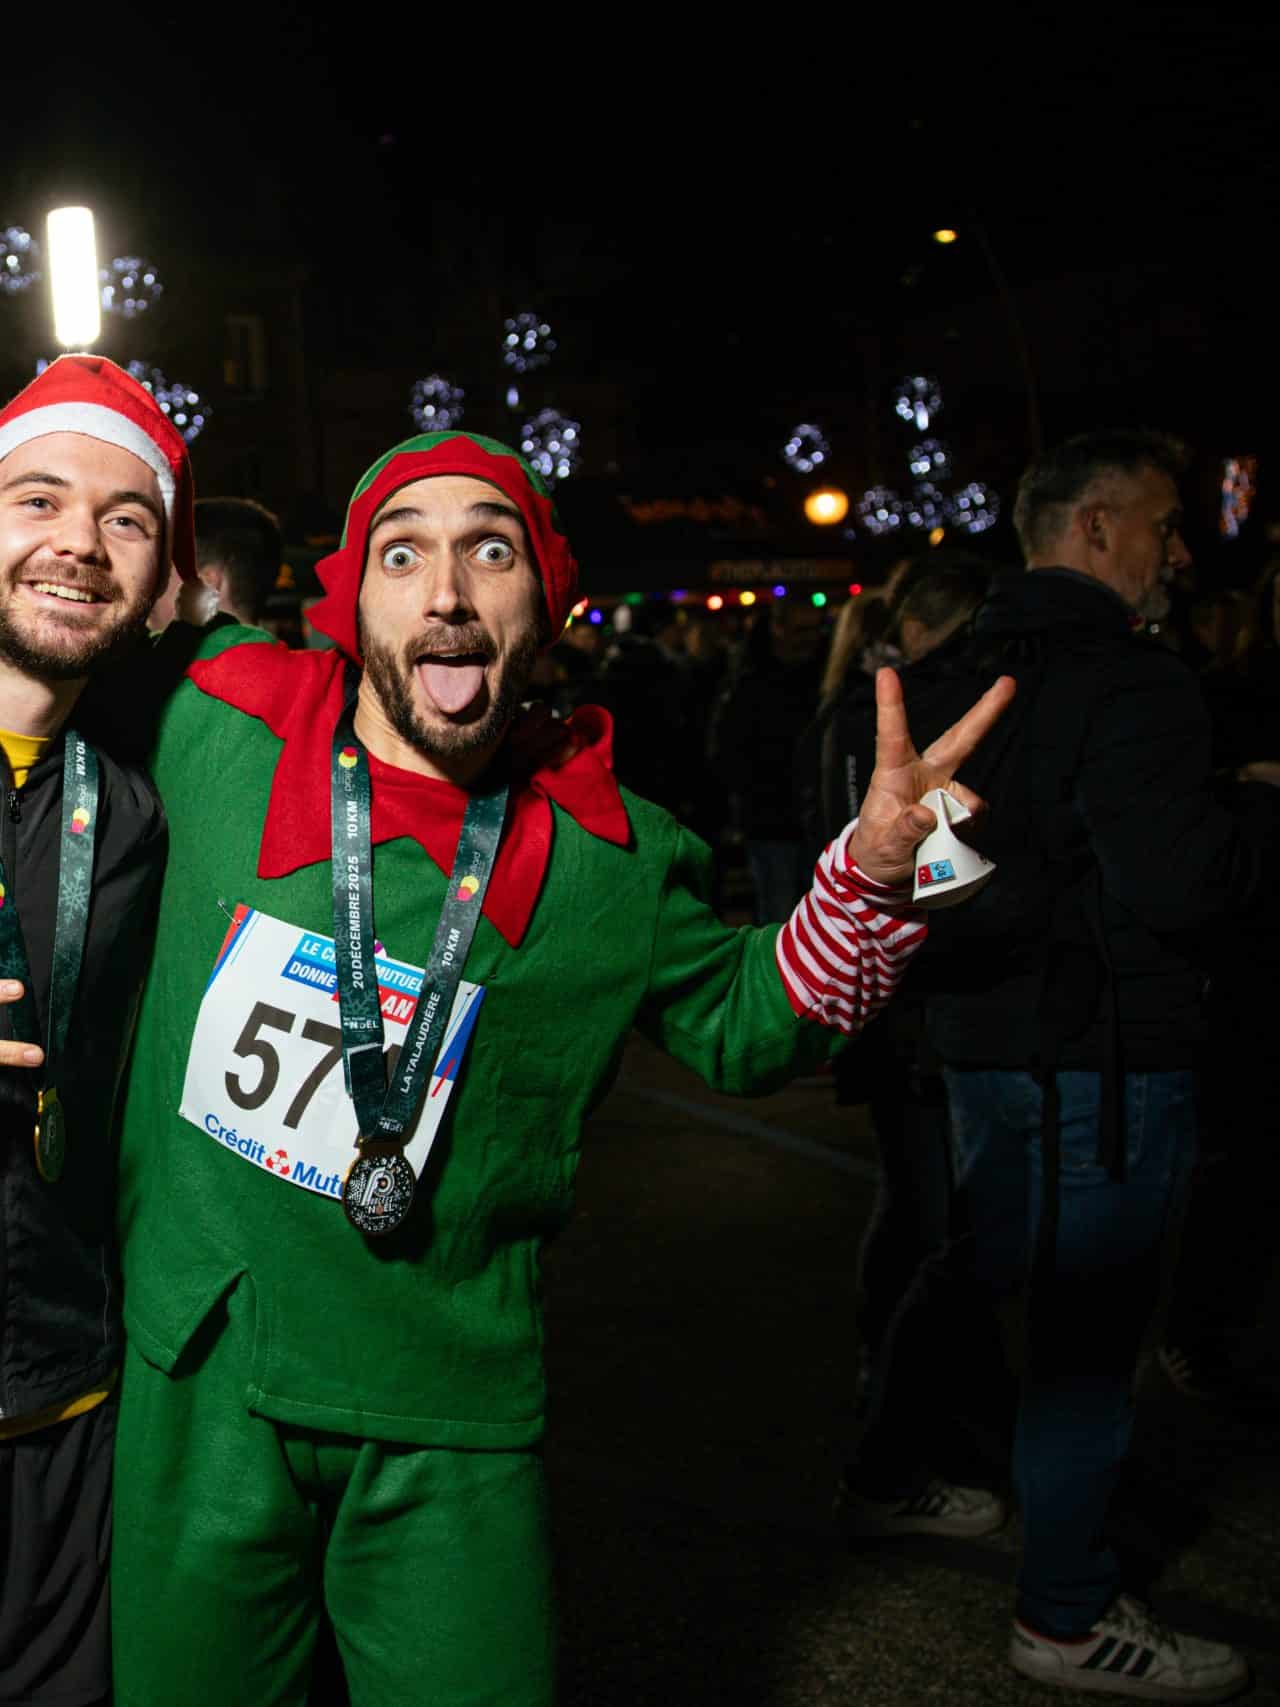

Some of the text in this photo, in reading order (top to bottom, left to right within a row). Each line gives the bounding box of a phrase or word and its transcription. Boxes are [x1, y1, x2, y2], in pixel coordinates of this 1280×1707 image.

[347, 855, 360, 890] 2025
[301, 939, 322, 957] LE
[289, 960, 338, 988] DONNE
[225, 1001, 402, 1130] 57
[400, 1075, 413, 1094] LA
[204, 1113, 267, 1164] Crédit
